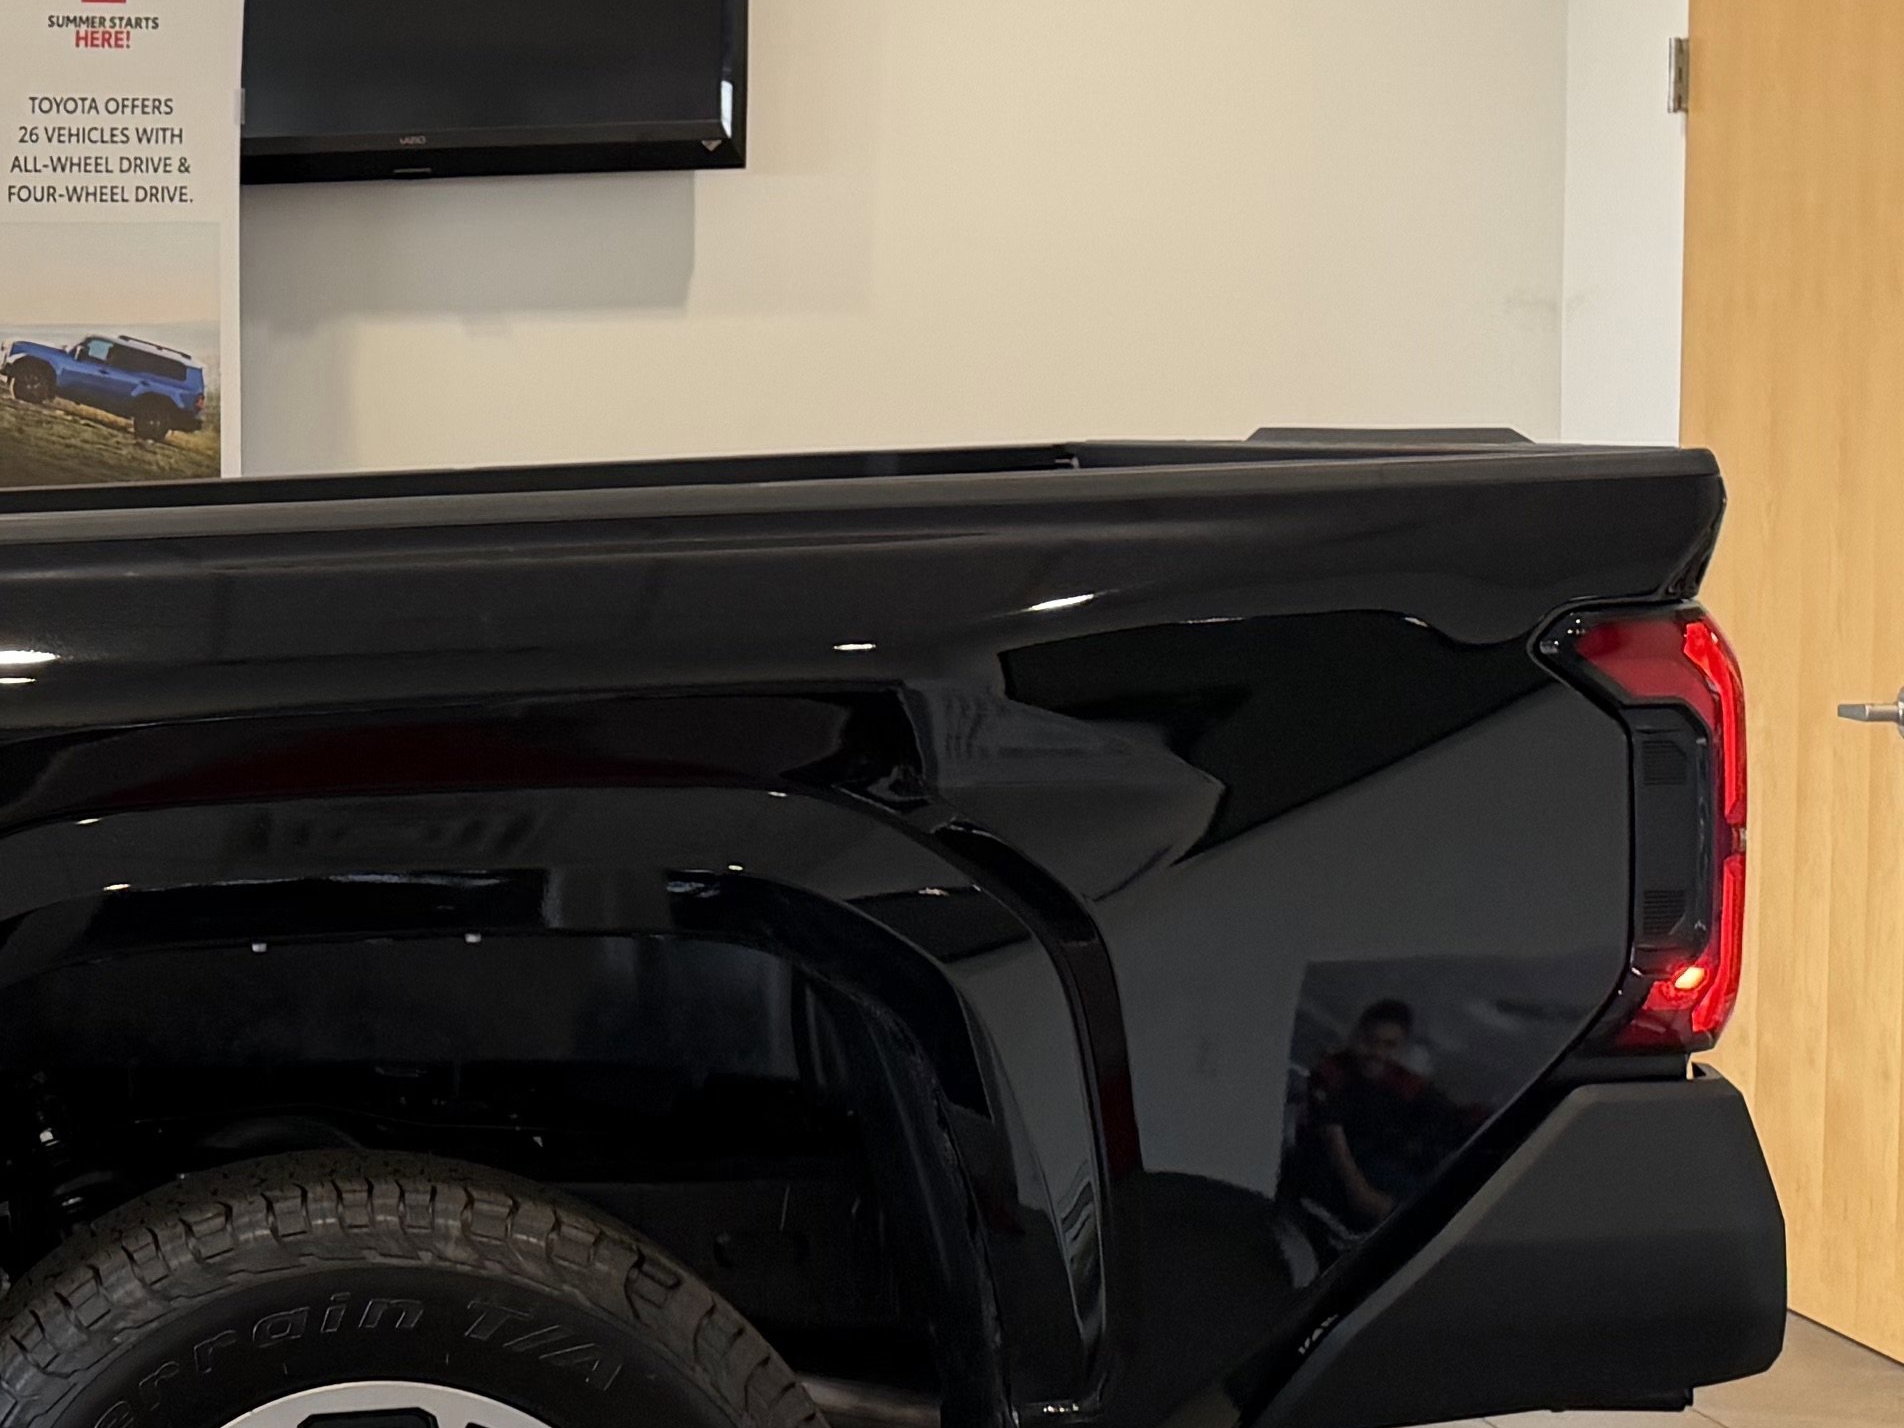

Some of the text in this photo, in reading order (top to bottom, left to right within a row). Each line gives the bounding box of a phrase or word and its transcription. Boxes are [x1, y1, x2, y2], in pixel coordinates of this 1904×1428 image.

[47, 15, 160, 30] SUMMER STARTS
[75, 29, 131, 48] HERE!
[28, 96, 174, 115] TOYOTA OFFERS
[18, 126, 184, 144] 26 VEHICLES WITH
[9, 155, 191, 174] ALL-WHEEL DRIVE &
[7, 185, 194, 203] FOUR-WHEEL DRIVE.
